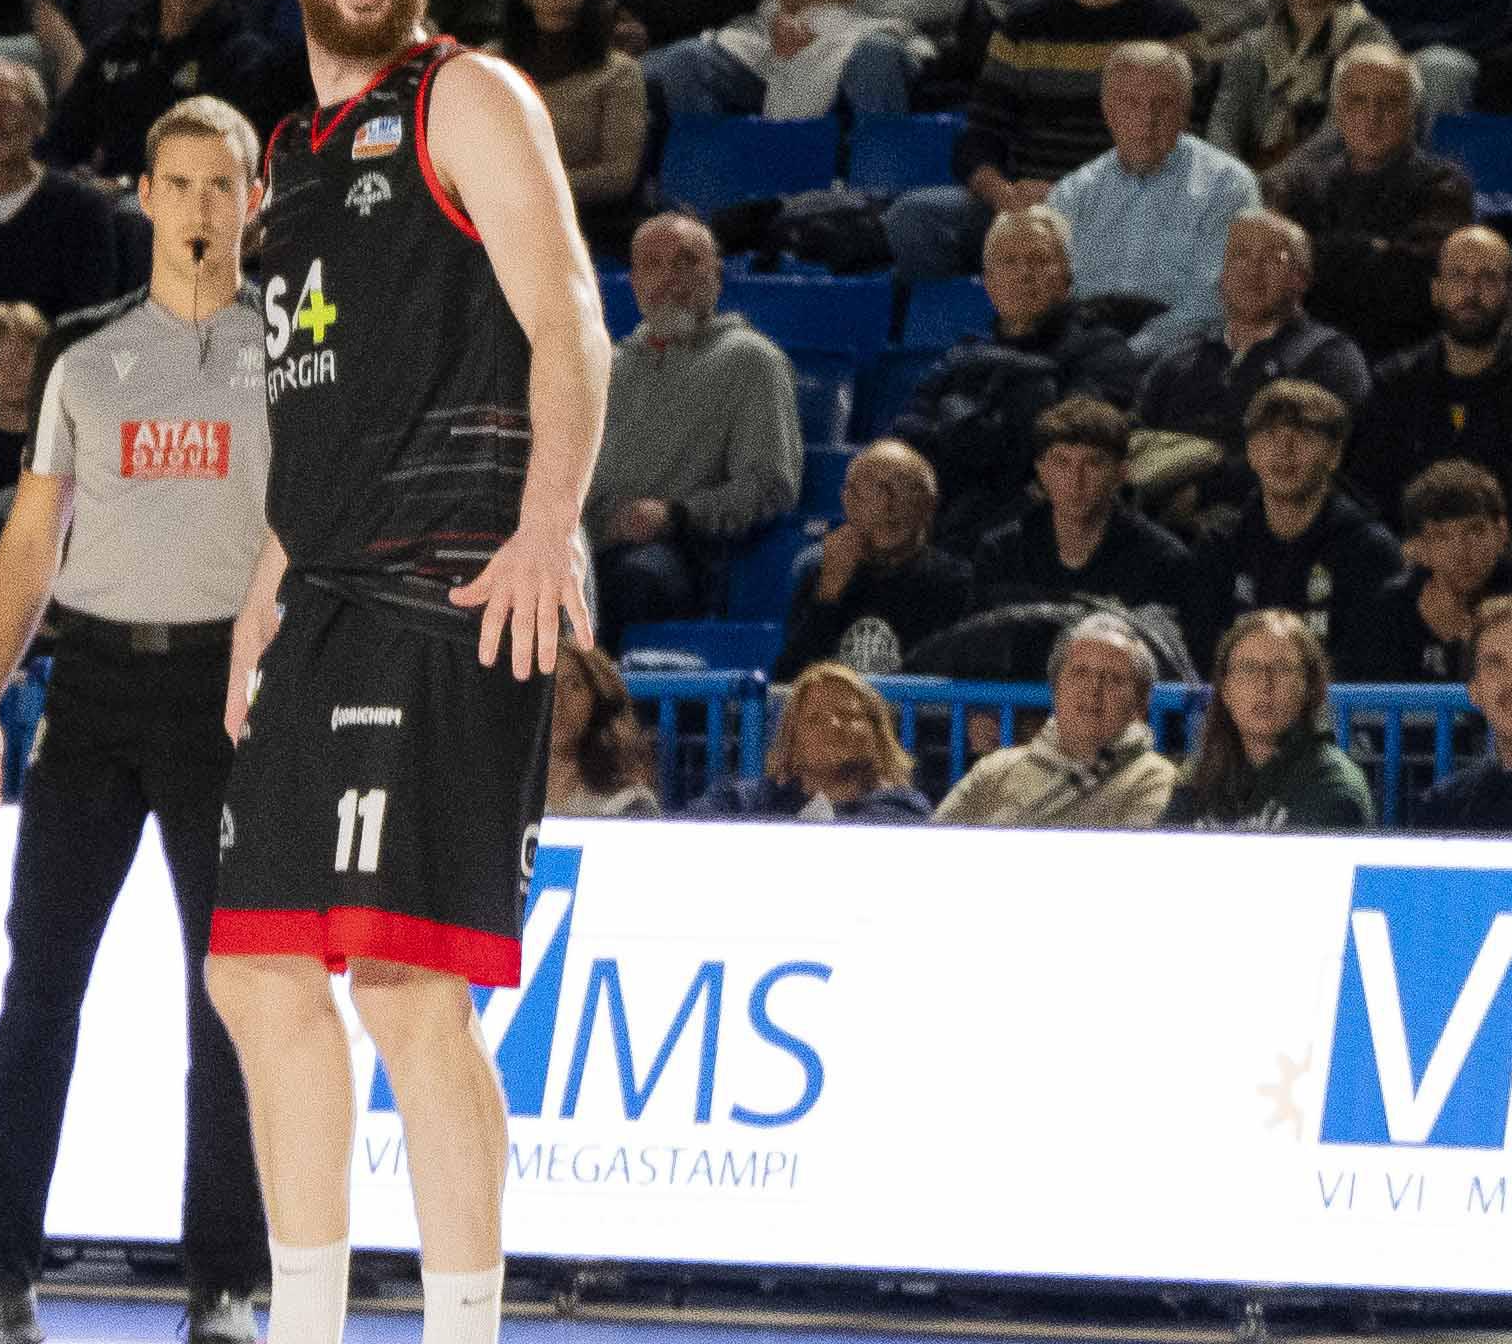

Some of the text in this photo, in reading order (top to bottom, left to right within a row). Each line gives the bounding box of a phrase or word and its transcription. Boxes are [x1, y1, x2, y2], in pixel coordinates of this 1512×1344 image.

[334, 788, 387, 873] 11
[506, 1142, 800, 1191] MEGASTAMPI
[1317, 1170, 1356, 1211] VI
[1385, 1172, 1425, 1213] VI
